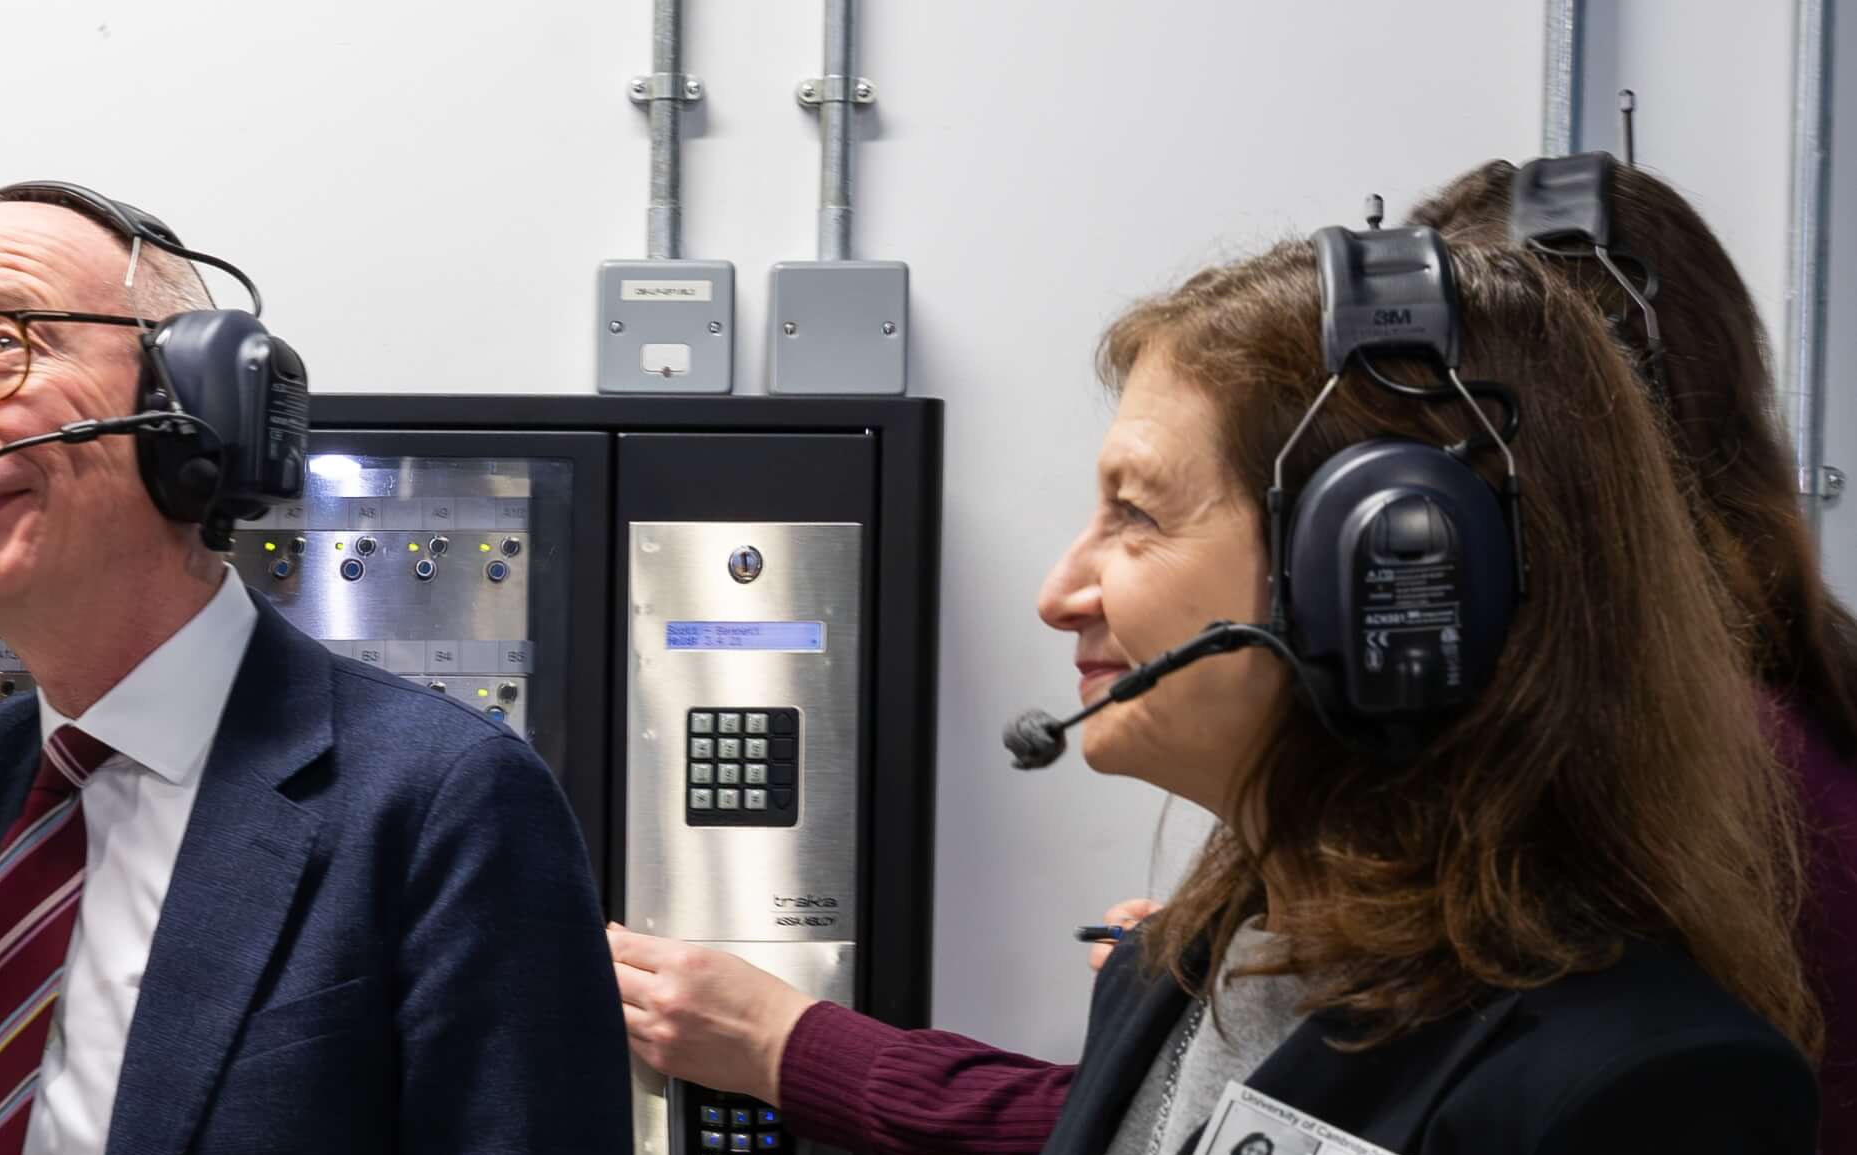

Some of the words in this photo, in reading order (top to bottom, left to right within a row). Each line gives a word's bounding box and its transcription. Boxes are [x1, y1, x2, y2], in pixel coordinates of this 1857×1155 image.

[1374, 309, 1412, 326] 3M
[774, 894, 839, 908] traka
[1239, 1089, 1301, 1124] University
[1302, 1118, 1316, 1131] of
[1315, 1124, 1369, 1155] Cambridge
